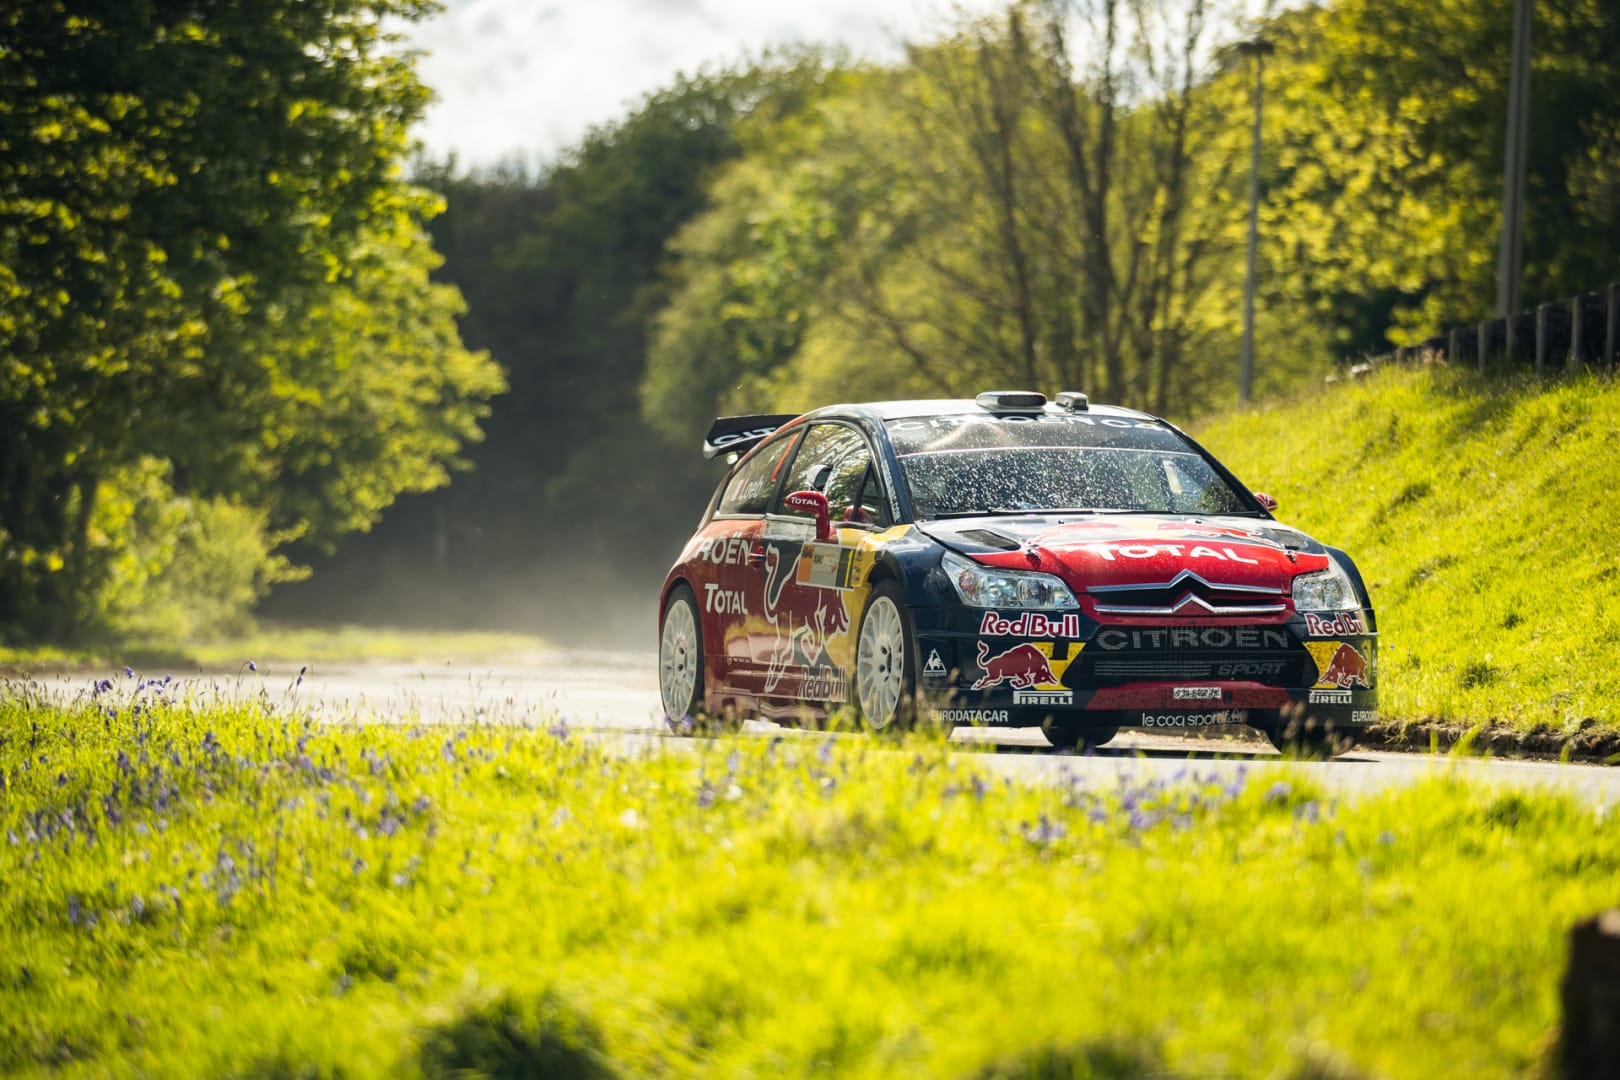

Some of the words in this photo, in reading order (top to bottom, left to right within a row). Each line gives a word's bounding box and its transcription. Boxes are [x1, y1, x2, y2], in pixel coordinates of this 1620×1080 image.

[1096, 544, 1259, 565] TOTAL
[704, 583, 749, 615] TOTAL
[1217, 661, 1287, 675] SPORT
[1013, 690, 1074, 705] PIRELLI
[1308, 690, 1352, 704] PIRELLI
[1141, 712, 1155, 727] le
[1156, 714, 1185, 727] coq
